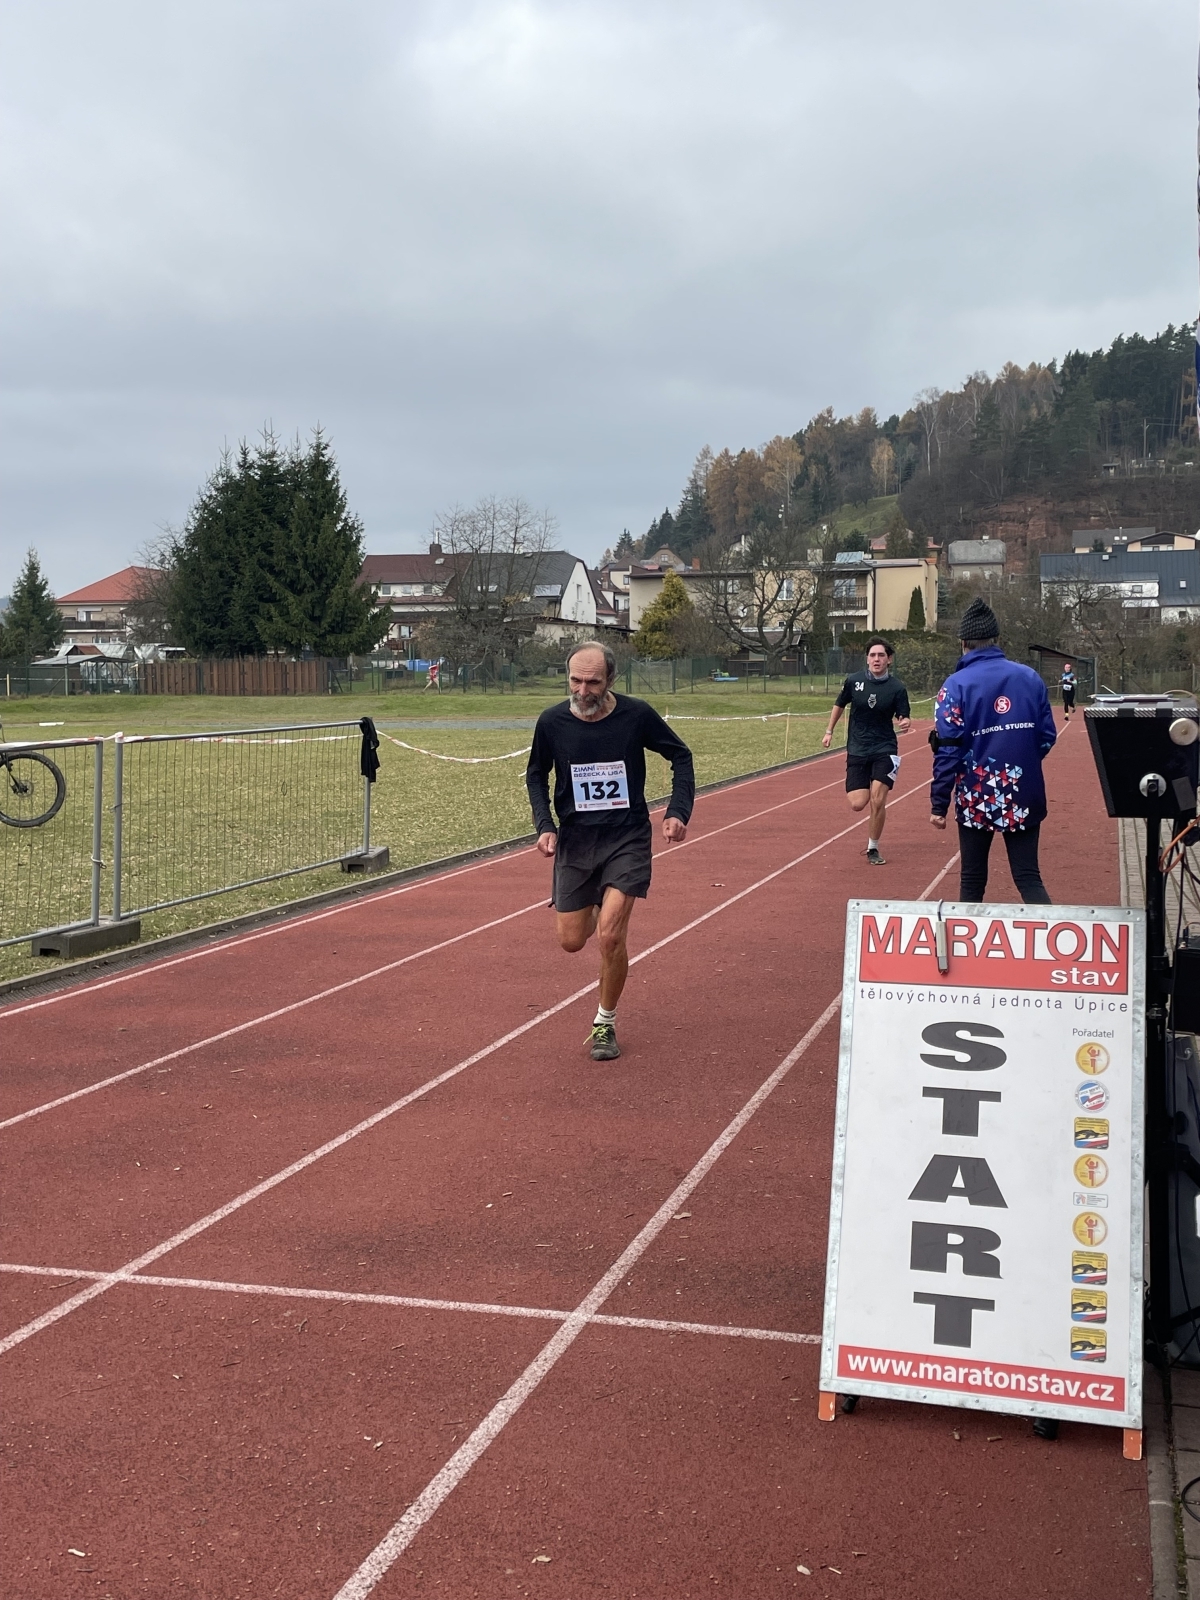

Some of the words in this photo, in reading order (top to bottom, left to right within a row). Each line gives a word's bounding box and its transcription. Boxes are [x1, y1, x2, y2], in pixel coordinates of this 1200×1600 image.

[854, 681, 865, 692] 34
[982, 725, 1004, 734] SOKOL
[580, 780, 621, 801] 132
[861, 915, 1129, 963] MARATON
[1050, 967, 1120, 987] stav
[860, 988, 982, 1006] tělovýchovná
[991, 995, 1063, 1010] jednota
[1074, 996, 1129, 1013] Úpice
[1072, 1027, 1114, 1039] Pořadatel
[907, 1021, 1008, 1349] START
[847, 1353, 1115, 1402] www.maratonstav.cz
